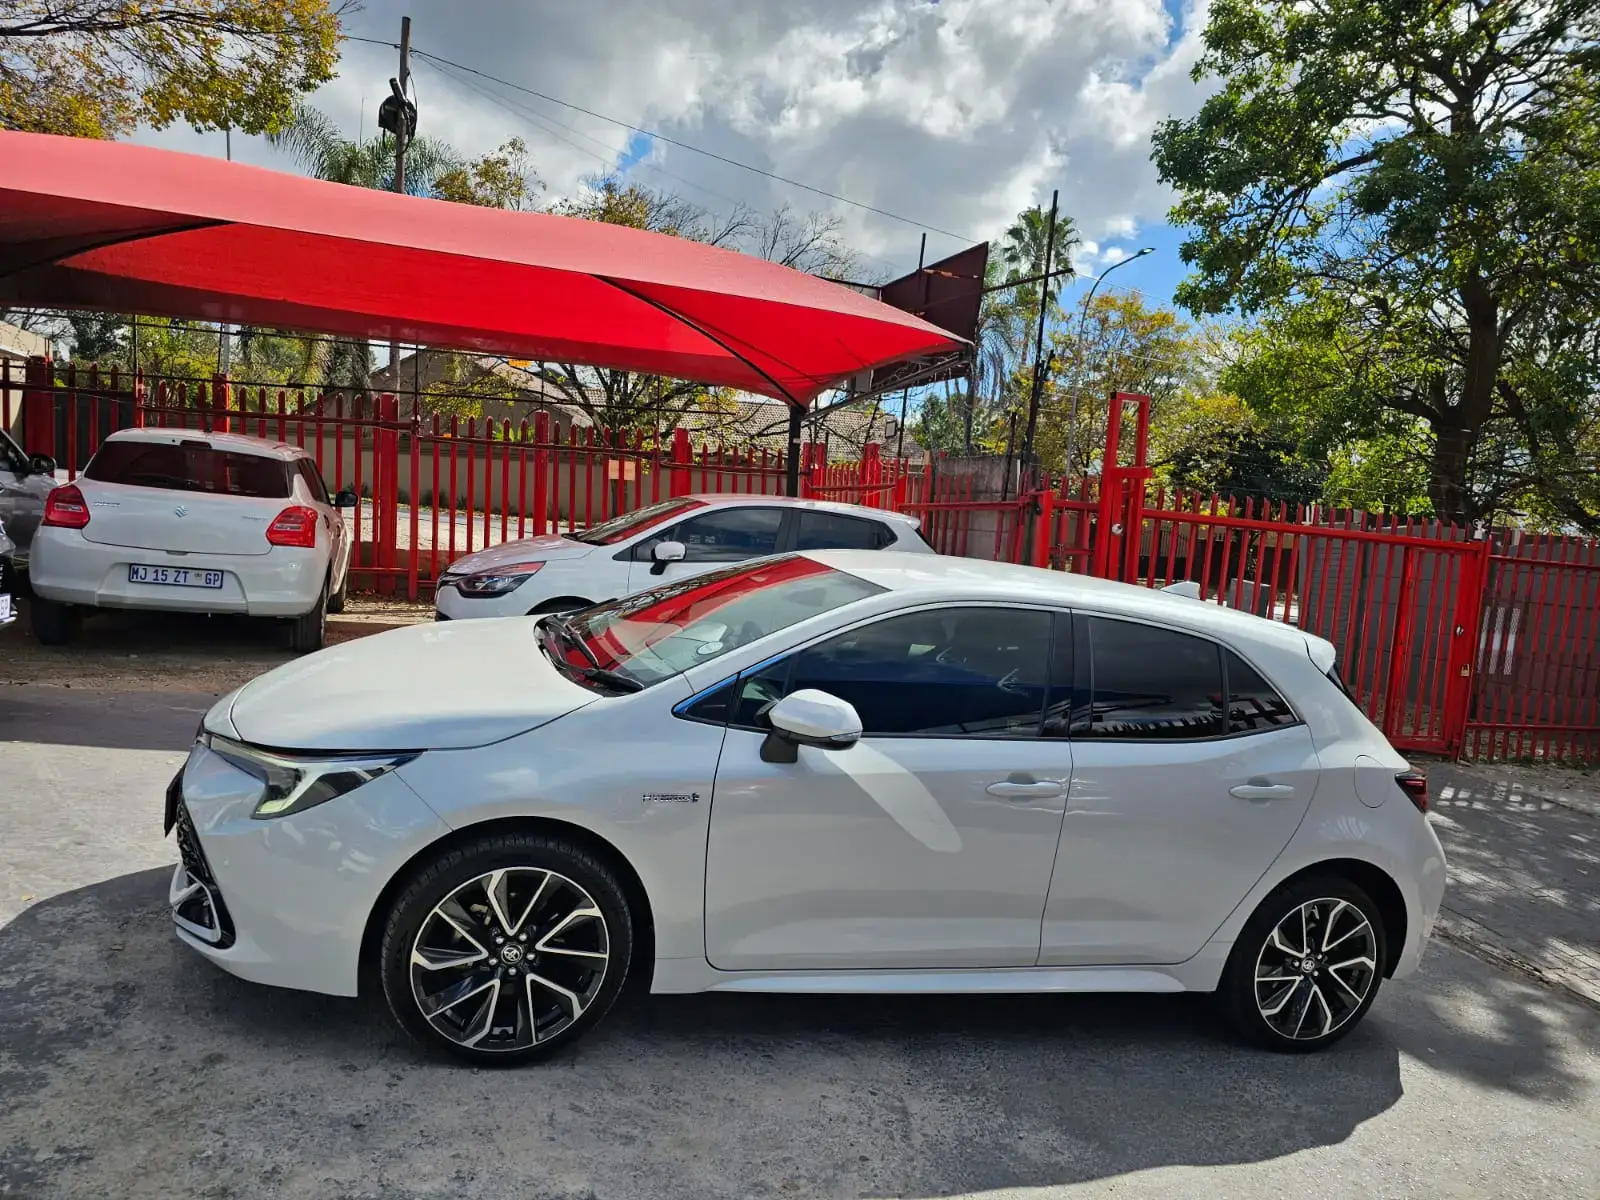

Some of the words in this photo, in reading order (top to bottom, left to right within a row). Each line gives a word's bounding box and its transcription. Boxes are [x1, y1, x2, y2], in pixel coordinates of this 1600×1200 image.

[131, 567, 147, 581] MJ
[152, 568, 169, 582] 15
[173, 570, 190, 583] ZT
[205, 572, 220, 585] GP
